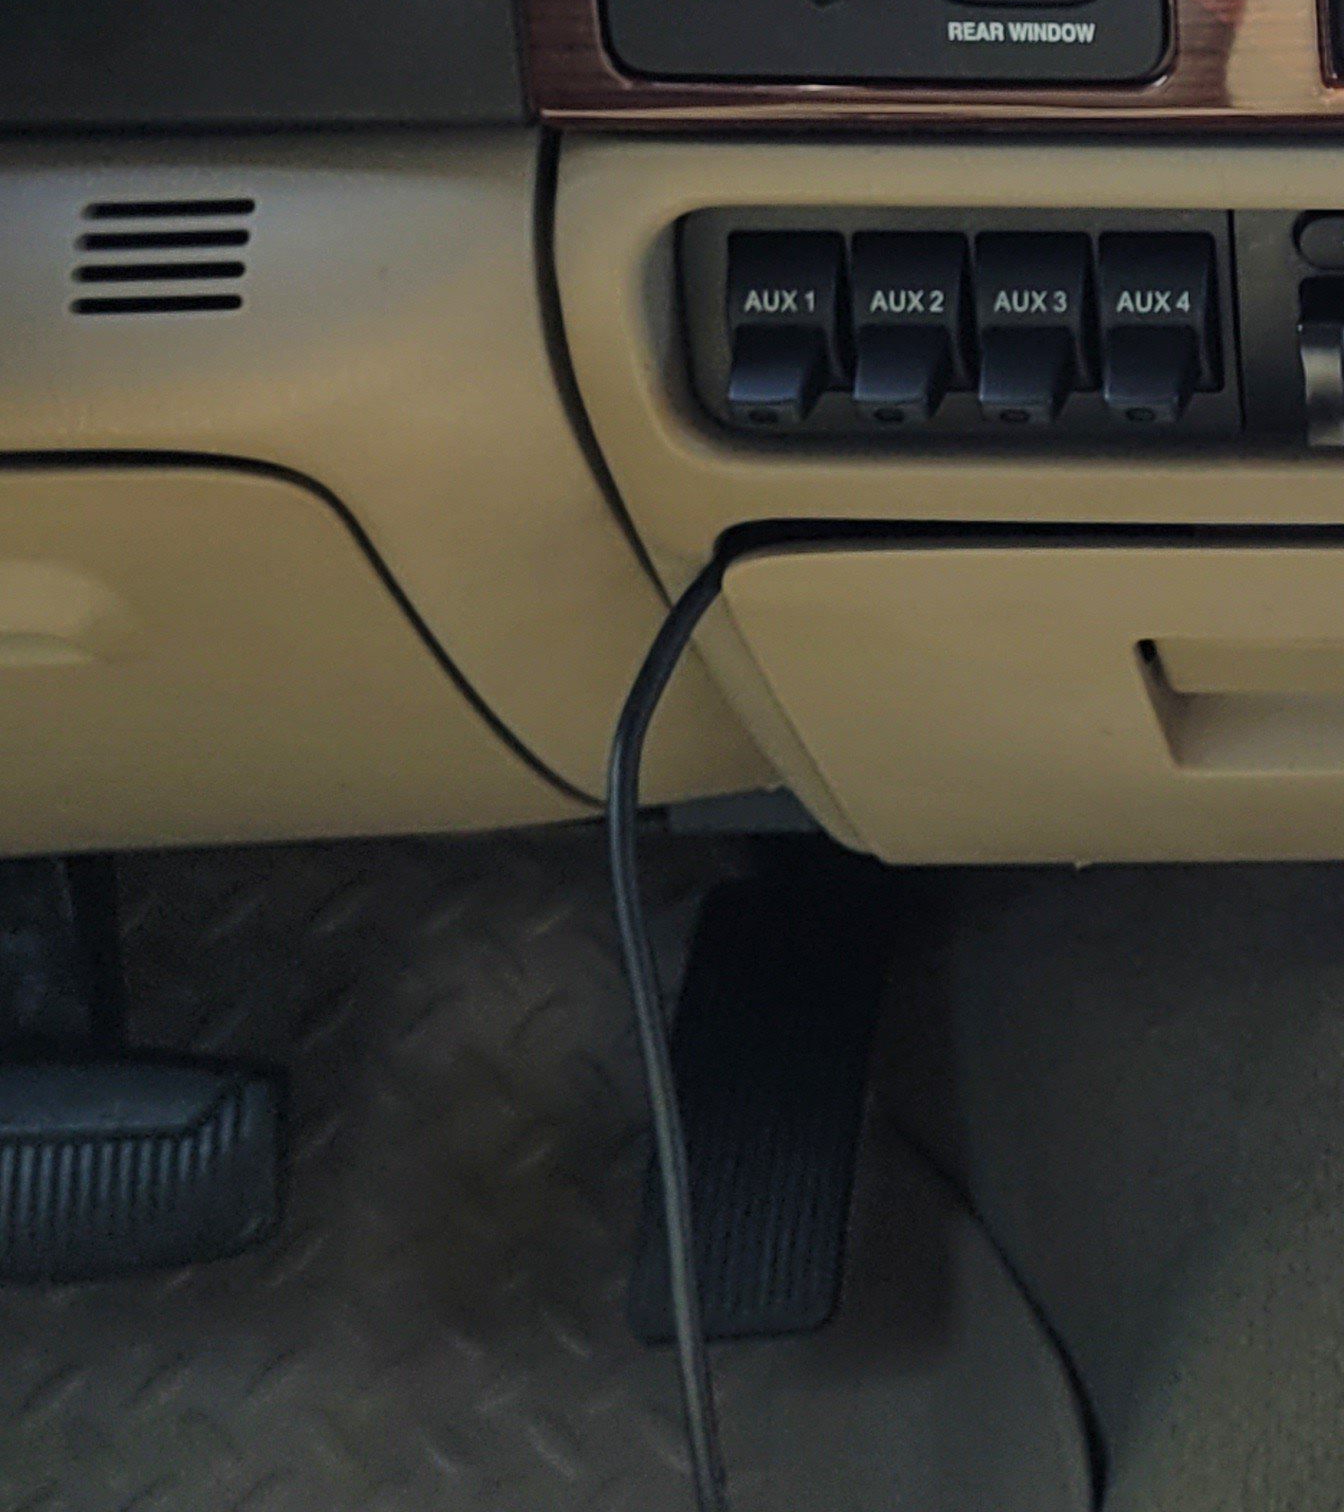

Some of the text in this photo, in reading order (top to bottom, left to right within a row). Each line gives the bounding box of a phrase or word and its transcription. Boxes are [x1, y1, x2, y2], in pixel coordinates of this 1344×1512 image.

[948, 21, 1095, 43] REAR WINDOW
[744, 290, 815, 312] AUX 1
[870, 289, 944, 313] AUX 2
[994, 290, 1067, 313] AUX 3
[1116, 290, 1190, 313] AUX 4
